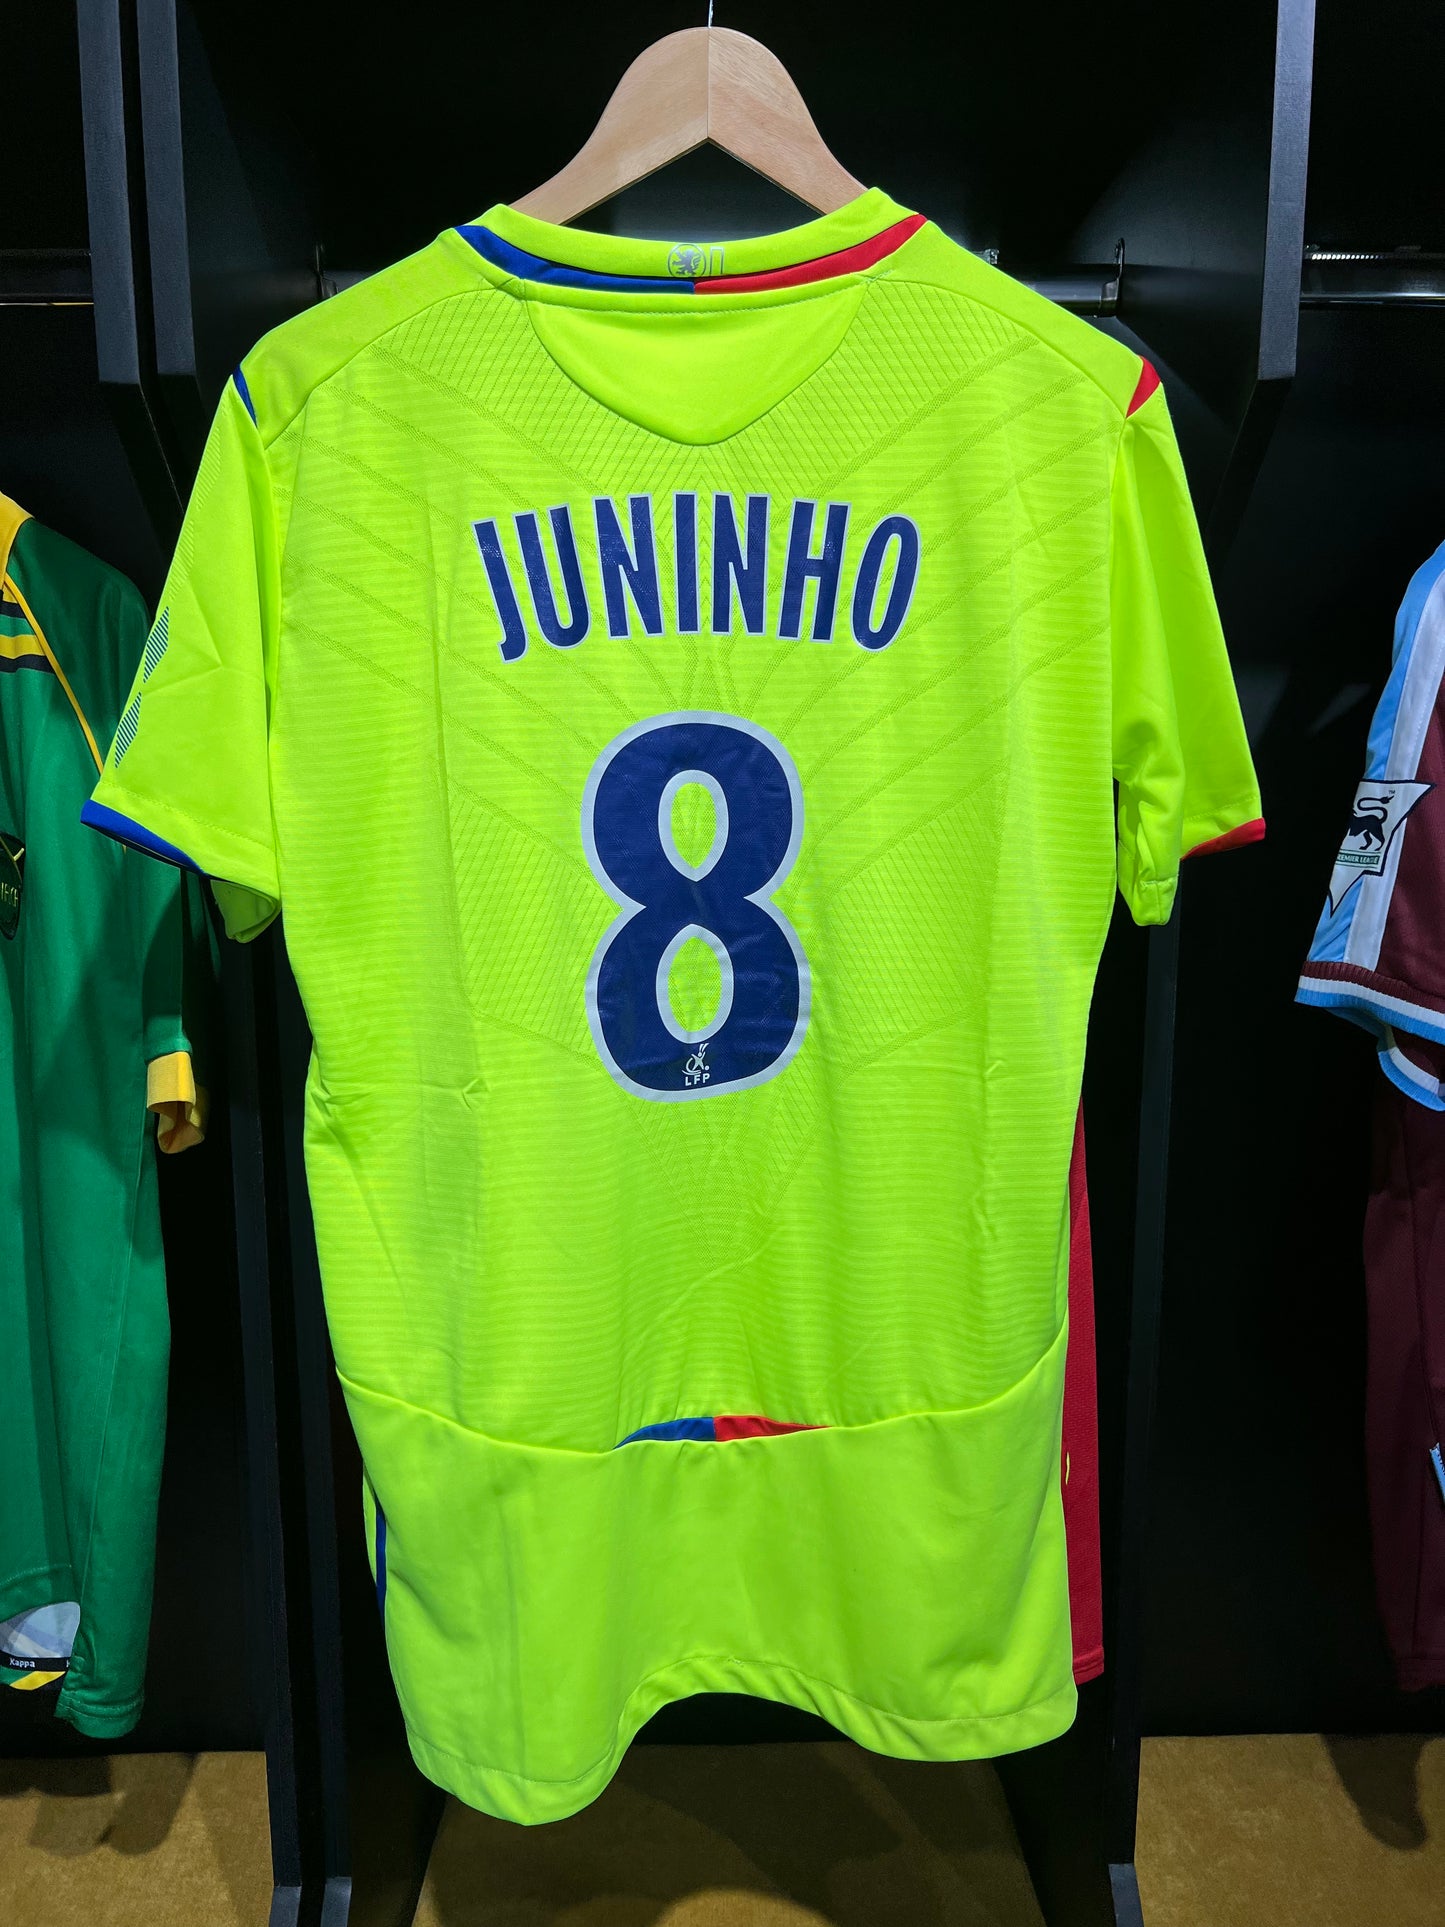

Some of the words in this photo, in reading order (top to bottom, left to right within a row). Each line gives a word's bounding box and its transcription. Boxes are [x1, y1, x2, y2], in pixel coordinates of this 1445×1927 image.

[471, 491, 922, 663] JUNINHO
[1337, 854, 1360, 863] REMIER
[581, 710, 812, 1102] 8
[685, 1073, 710, 1086] LFP
[10, 1658, 35, 1668] Kappa
